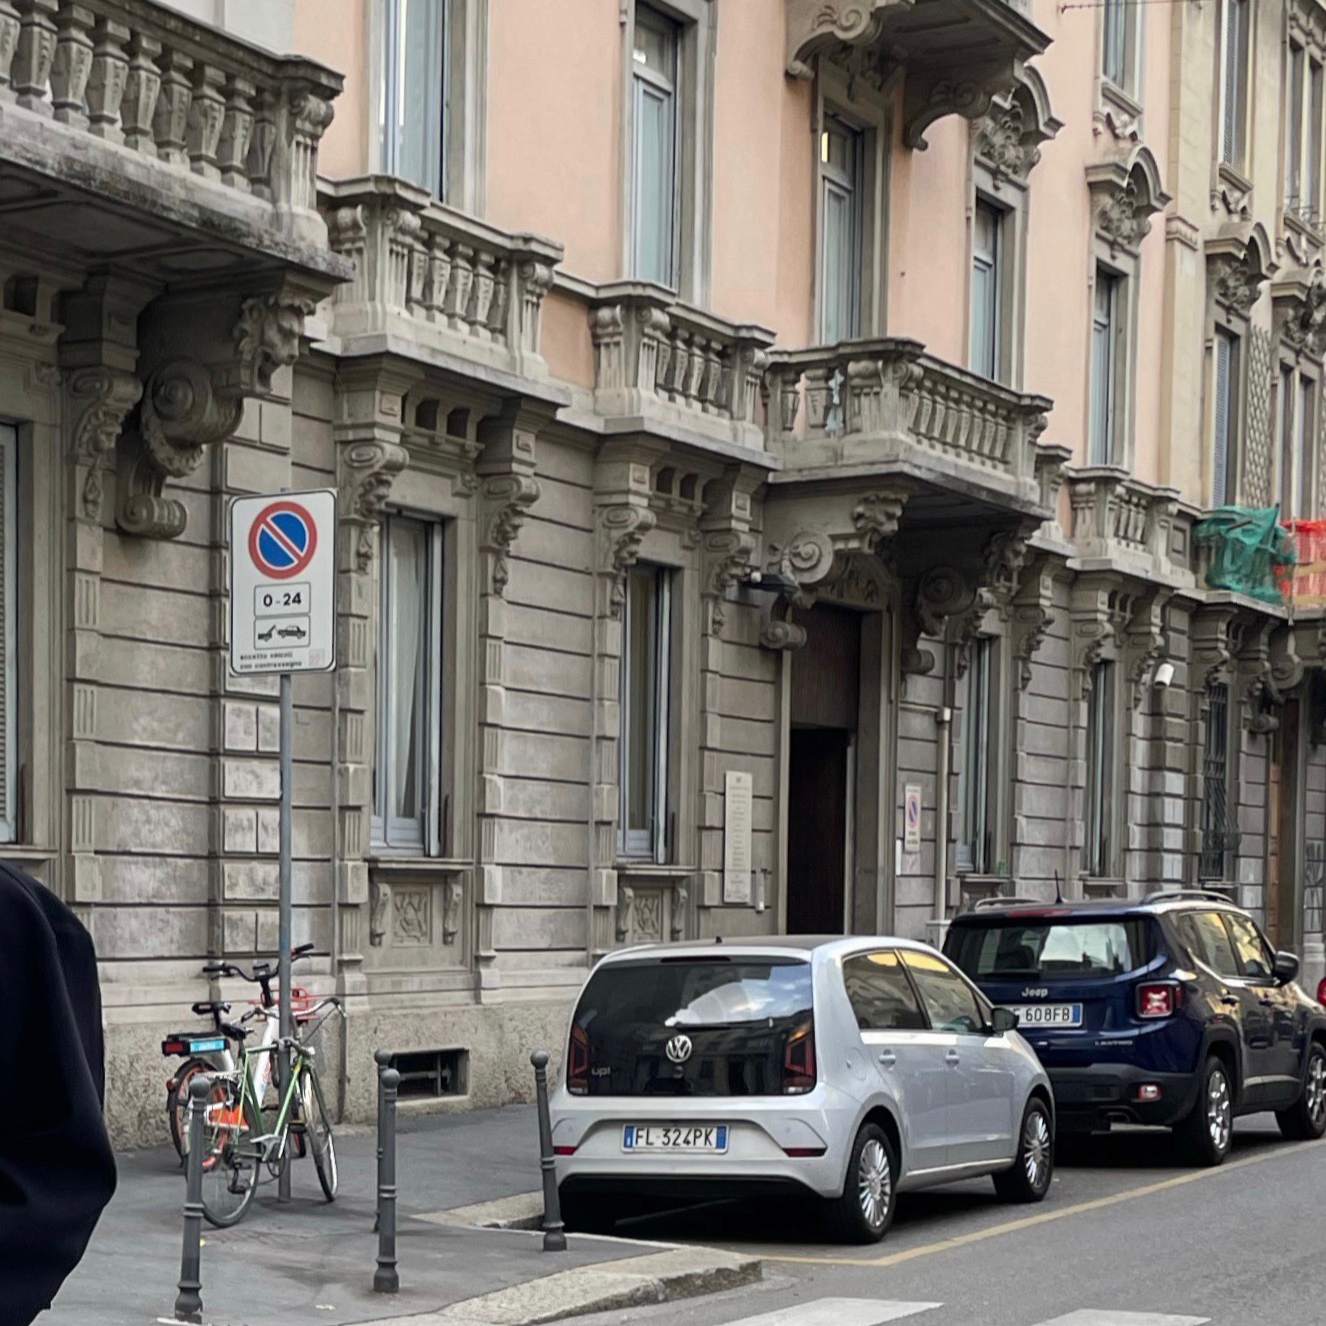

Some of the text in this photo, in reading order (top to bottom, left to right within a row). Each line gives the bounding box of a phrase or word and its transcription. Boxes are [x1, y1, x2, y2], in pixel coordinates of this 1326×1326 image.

[263, 594, 273, 608] 0
[283, 592, 302, 606] 24
[1021, 986, 1048, 998] Jeep
[1025, 1007, 1070, 1022] 608FB
